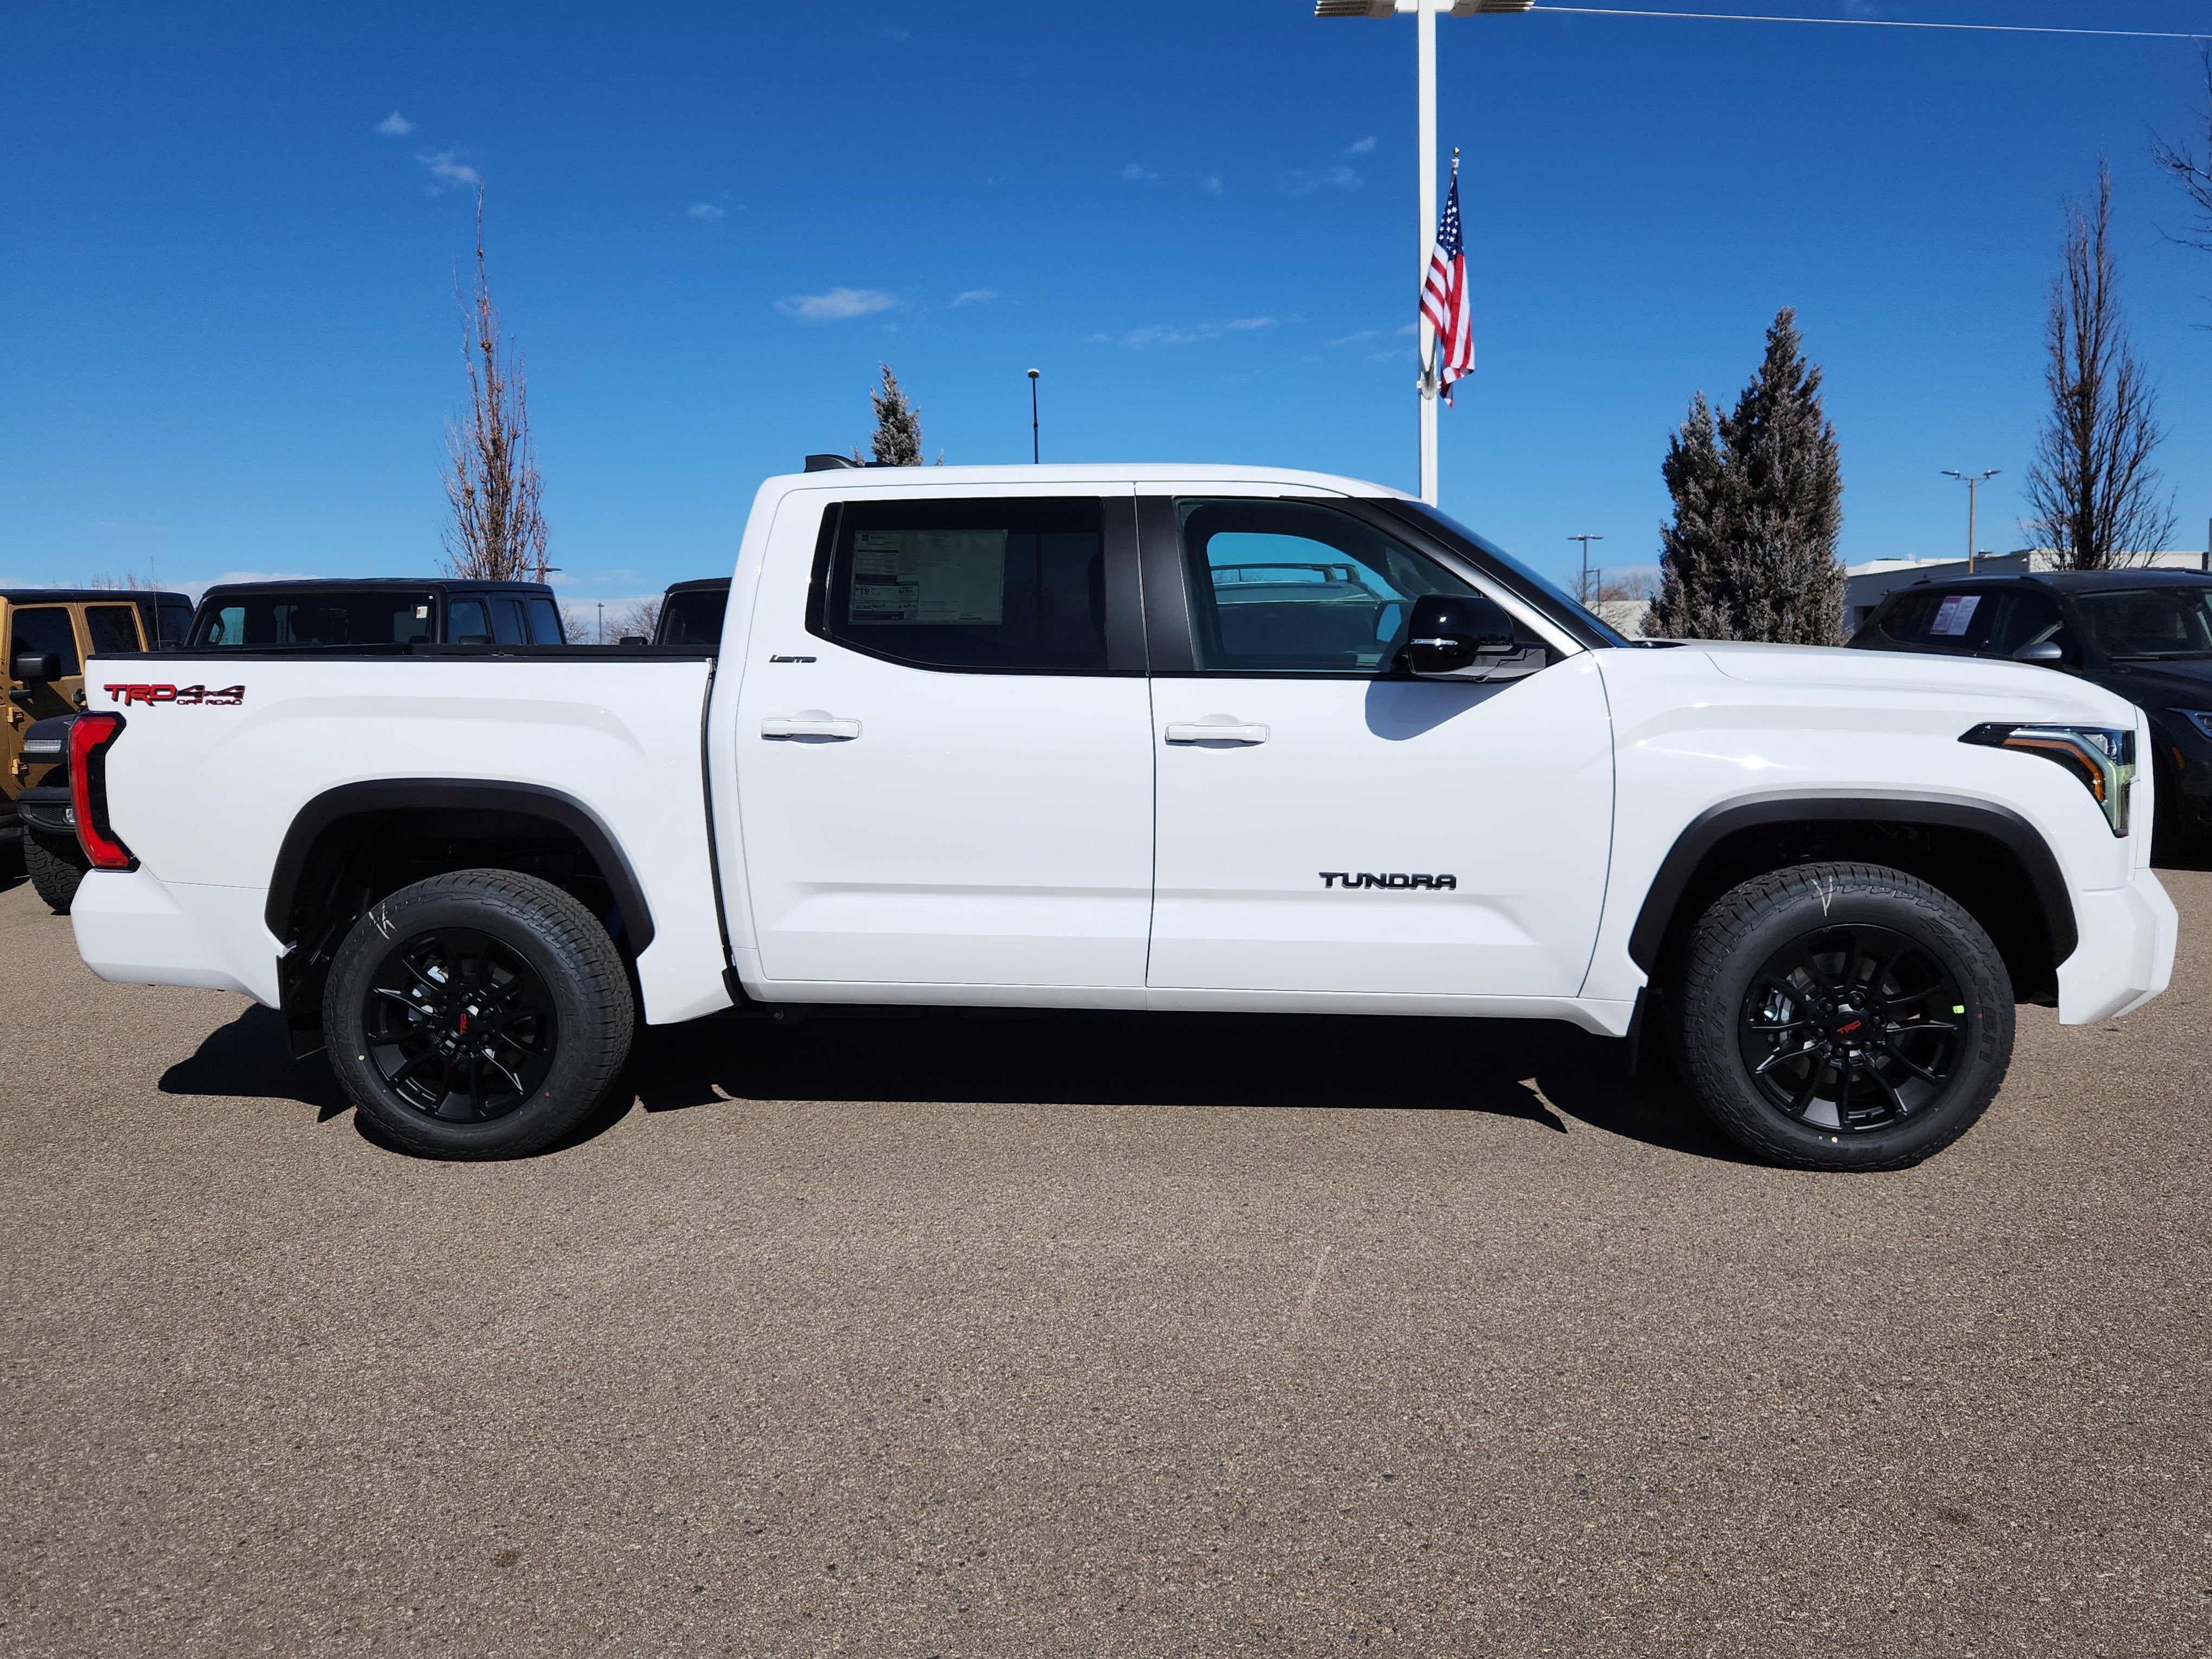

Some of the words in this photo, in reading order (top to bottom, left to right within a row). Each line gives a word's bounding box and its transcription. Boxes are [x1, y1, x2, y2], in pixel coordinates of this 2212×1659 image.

[104, 684, 178, 707] TRD
[1318, 872, 1457, 890] TUNDRA
[1836, 1019, 1861, 1034] TRD
